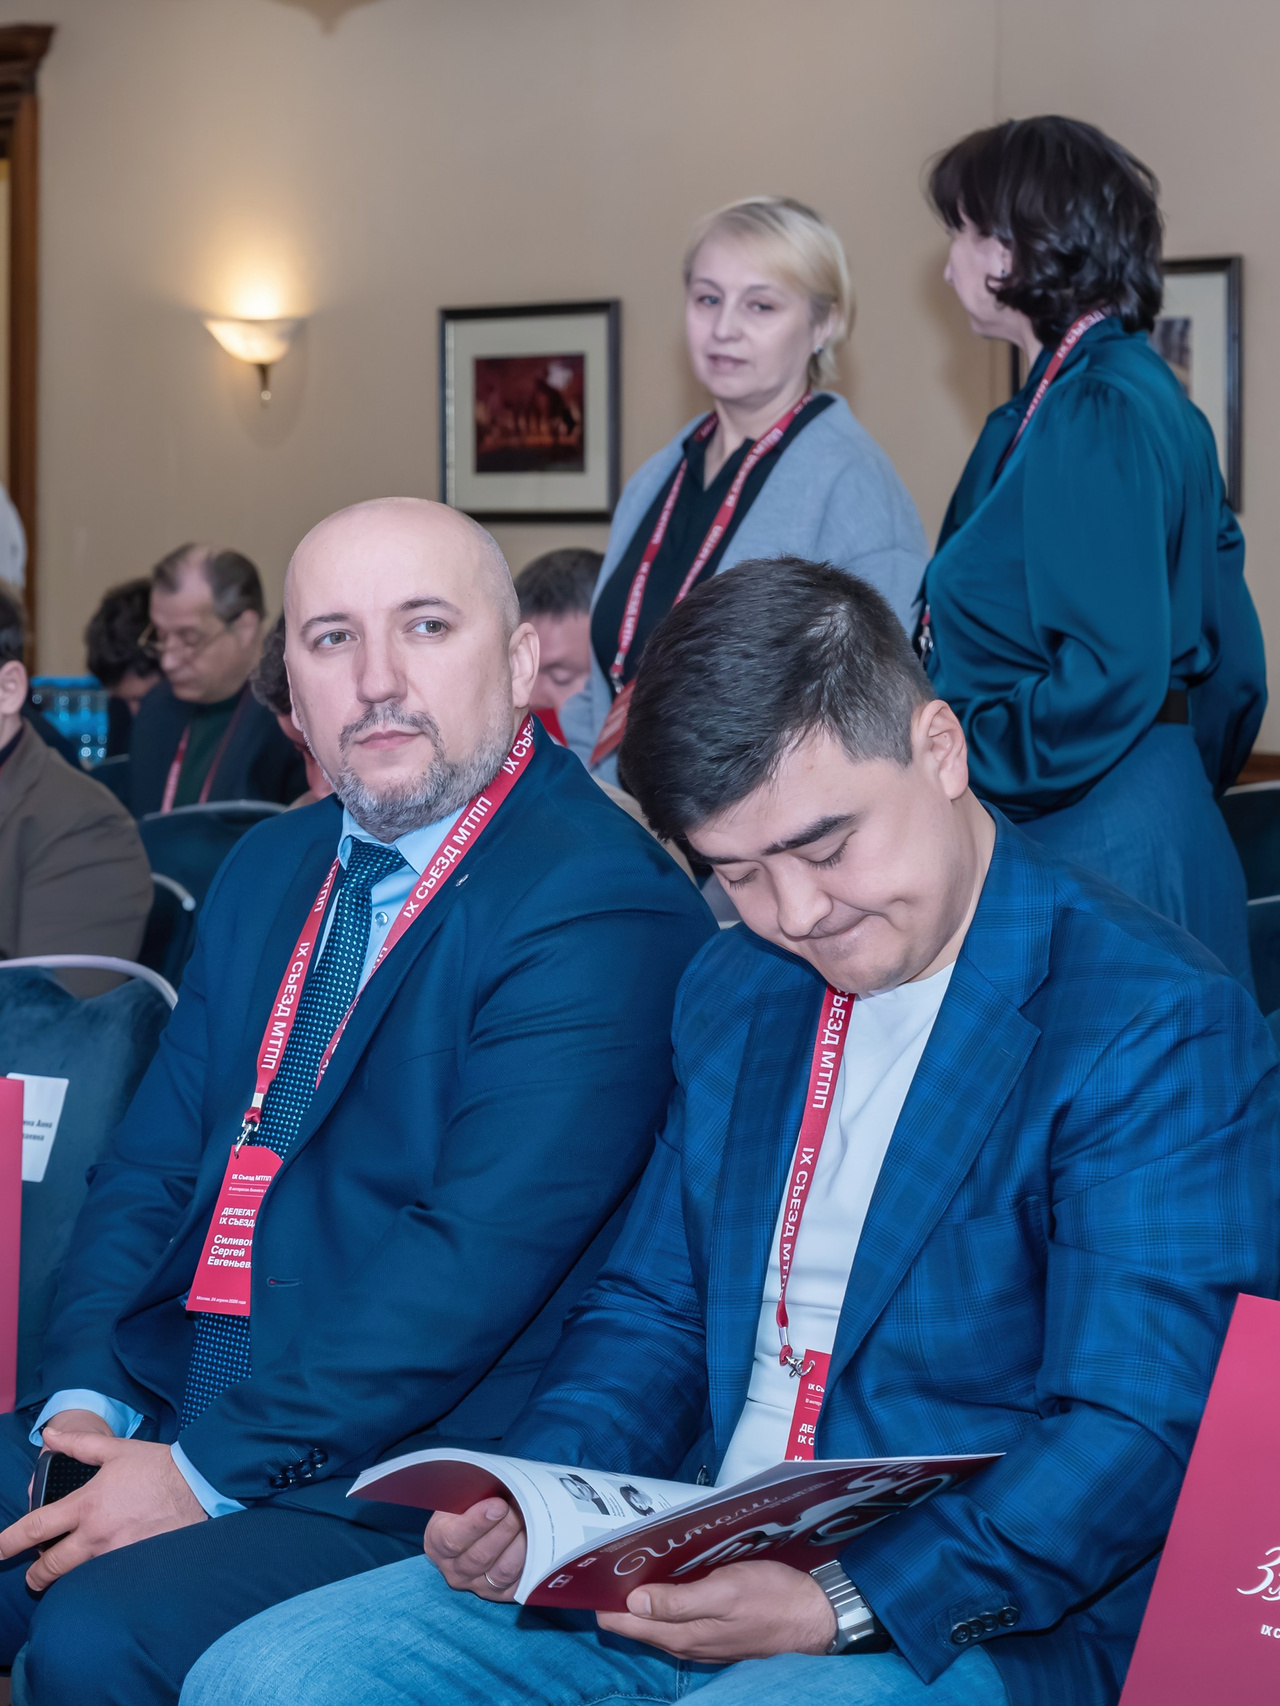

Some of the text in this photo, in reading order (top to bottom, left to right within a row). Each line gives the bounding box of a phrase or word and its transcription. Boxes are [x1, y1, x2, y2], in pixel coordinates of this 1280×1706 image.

[502, 716, 535, 775] IX СЪЕ
[403, 796, 492, 918] IX СЪЕЗД МТПП
[261, 942, 311, 1071] IX СЪЕЗД МТПП
[812, 1050, 836, 1109] МТПП
[800, 1147, 815, 1165] IX
[783, 1170, 808, 1238] СЪЕЗД
[221, 1207, 256, 1217] ДЕЛЕГАТ
[219, 1217, 256, 1228] IX СЪЕЗД
[211, 1245, 245, 1258] Сергей
[207, 1256, 252, 1269] Евгеньев
[808, 1383, 816, 1391] IX
[797, 1435, 807, 1445] IX
[1261, 1624, 1274, 1637] IX
